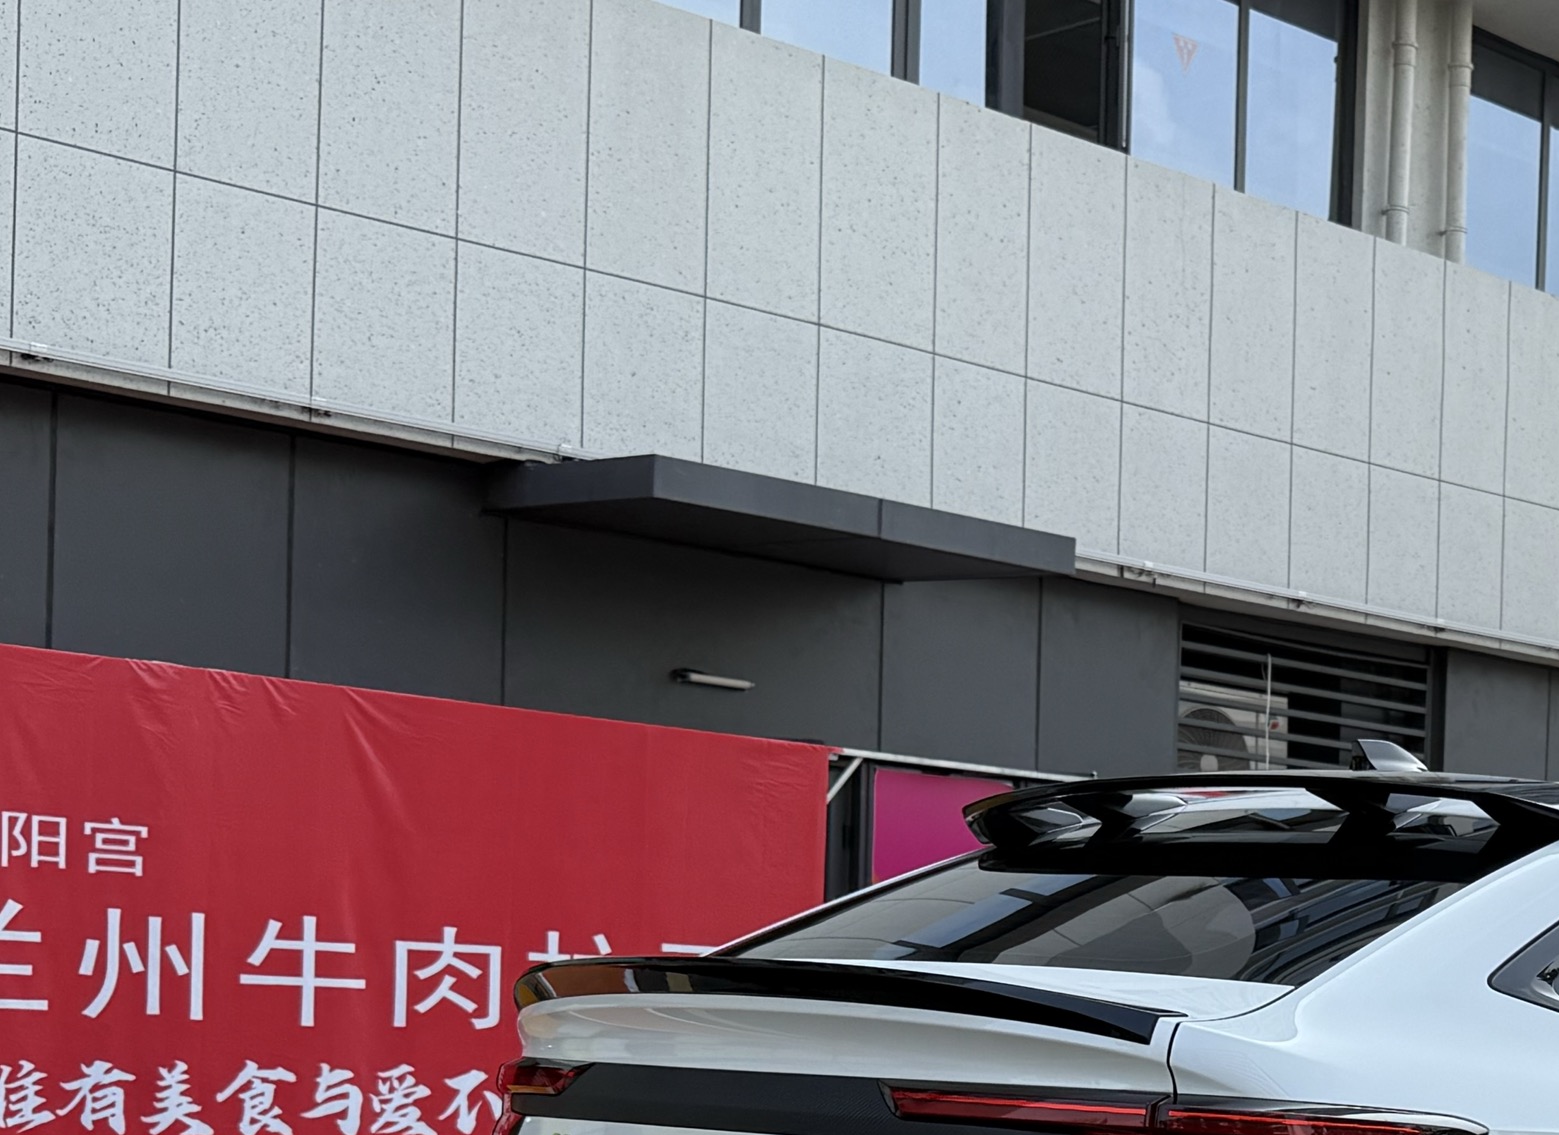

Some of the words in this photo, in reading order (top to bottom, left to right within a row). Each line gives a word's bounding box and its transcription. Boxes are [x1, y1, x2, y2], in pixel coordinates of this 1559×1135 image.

[1, 810, 149, 877] 阳宫
[0, 898, 718, 1029] 州牛肉
